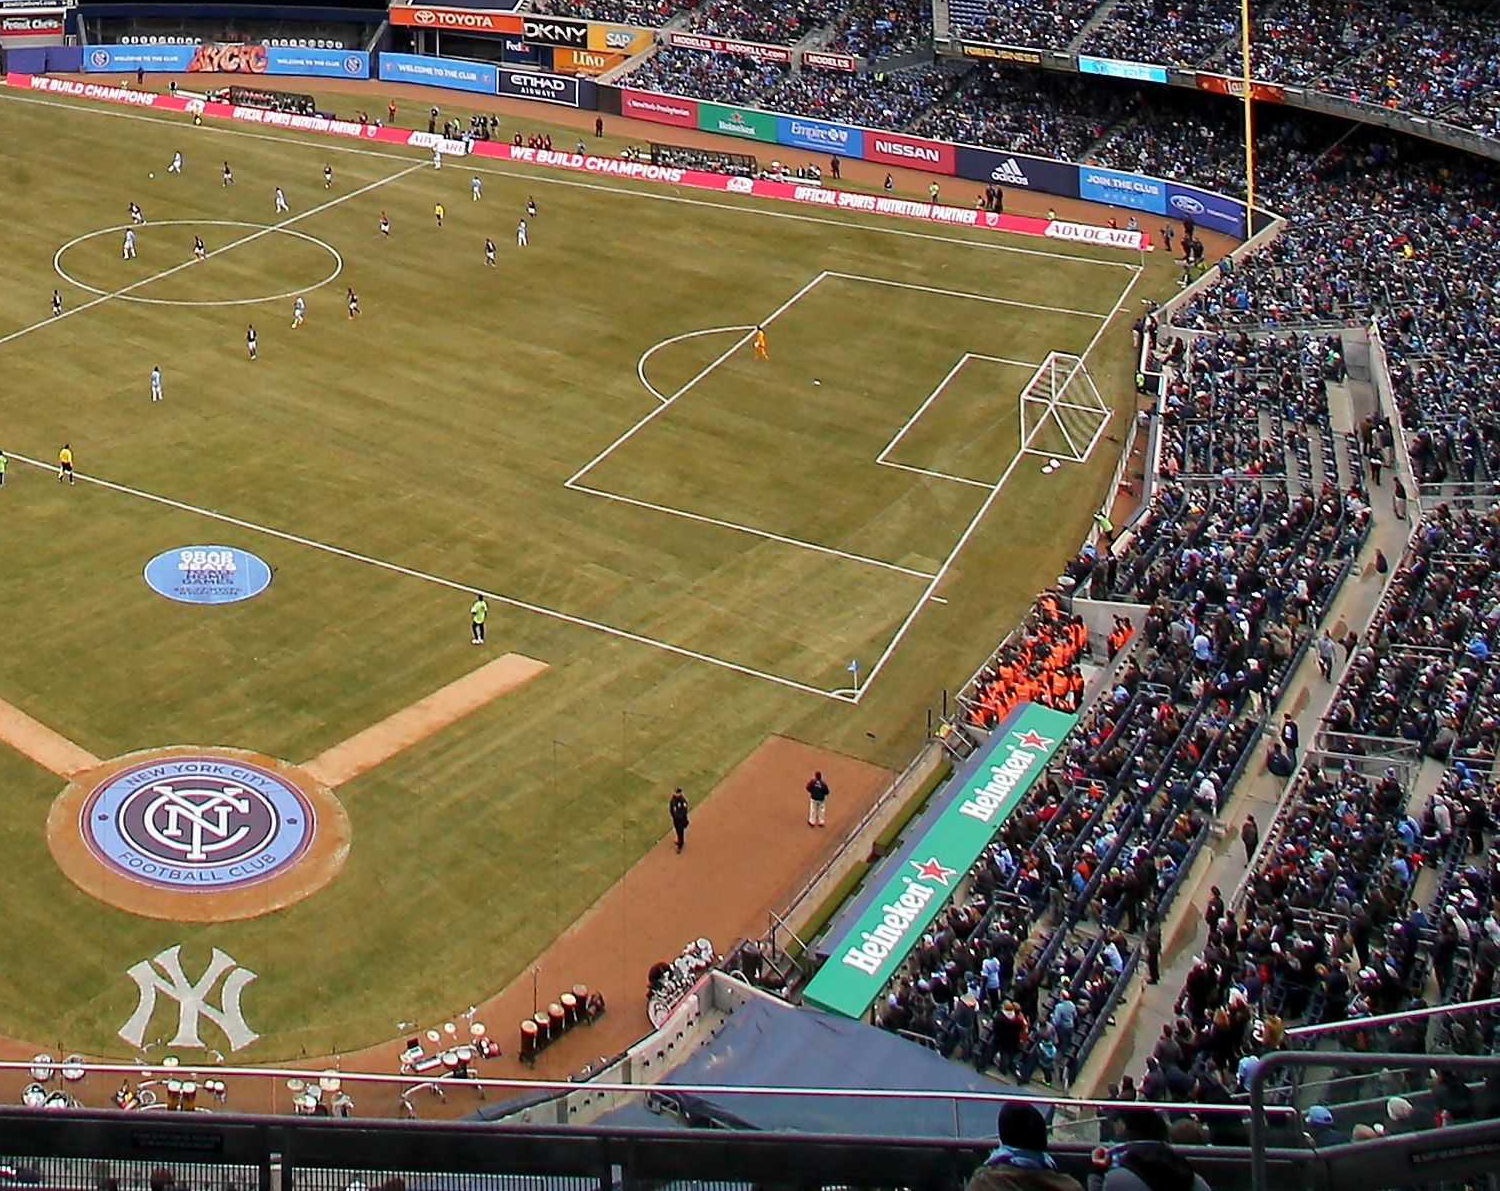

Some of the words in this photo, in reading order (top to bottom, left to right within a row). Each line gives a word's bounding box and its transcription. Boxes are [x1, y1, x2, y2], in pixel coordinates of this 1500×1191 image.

[437, 12, 494, 28] TOYOTA
[524, 21, 587, 43] DKNY
[605, 31, 632, 48] SAP
[505, 40, 531, 53] FedEx
[985, 48, 1041, 63] BUSINESS
[187, 43, 268, 74] NYCFC
[276, 58, 305, 66] WELCOME
[397, 64, 433, 76] WELCOME
[434, 67, 444, 77] TO
[444, 69, 458, 79] THE
[458, 70, 477, 81] CLUB
[510, 74, 566, 91] ETIHAD
[30, 76, 48, 90] WE
[49, 79, 84, 95] BUILD
[521, 87, 556, 98] AIRWAYS
[232, 106, 264, 123] OFFICIAL
[263, 110, 292, 126] SPORTS
[291, 114, 329, 132] NUTRITION
[329, 119, 363, 137] PARTNER
[718, 120, 756, 136] Heineken
[790, 121, 828, 140] Empire
[509, 145, 534, 160] WE
[535, 149, 584, 168] BUILD
[875, 139, 941, 162] NISSAN
[991, 170, 1030, 186] adidas
[1086, 174, 1112, 186] JOIN
[1111, 177, 1133, 191] THE
[1133, 181, 1161, 196] CLUB
[794, 185, 837, 206] OFFICIAL
[838, 190, 875, 211] SPORTS
[875, 196, 931, 219] NUTRITION
[930, 202, 978, 225] PARTNER
[1175, 198, 1199, 212] Ford
[1050, 223, 1139, 246] ADVOCARE
[125, 767, 166, 787] NEW
[172, 763, 225, 776] YORK
[230, 767, 272, 788] CITY
[958, 744, 1037, 823] Heineken
[117, 850, 224, 883] FOOTBALL
[228, 852, 278, 878] CLUB
[842, 875, 936, 977] Heineken
[116, 943, 261, 1054] NY
